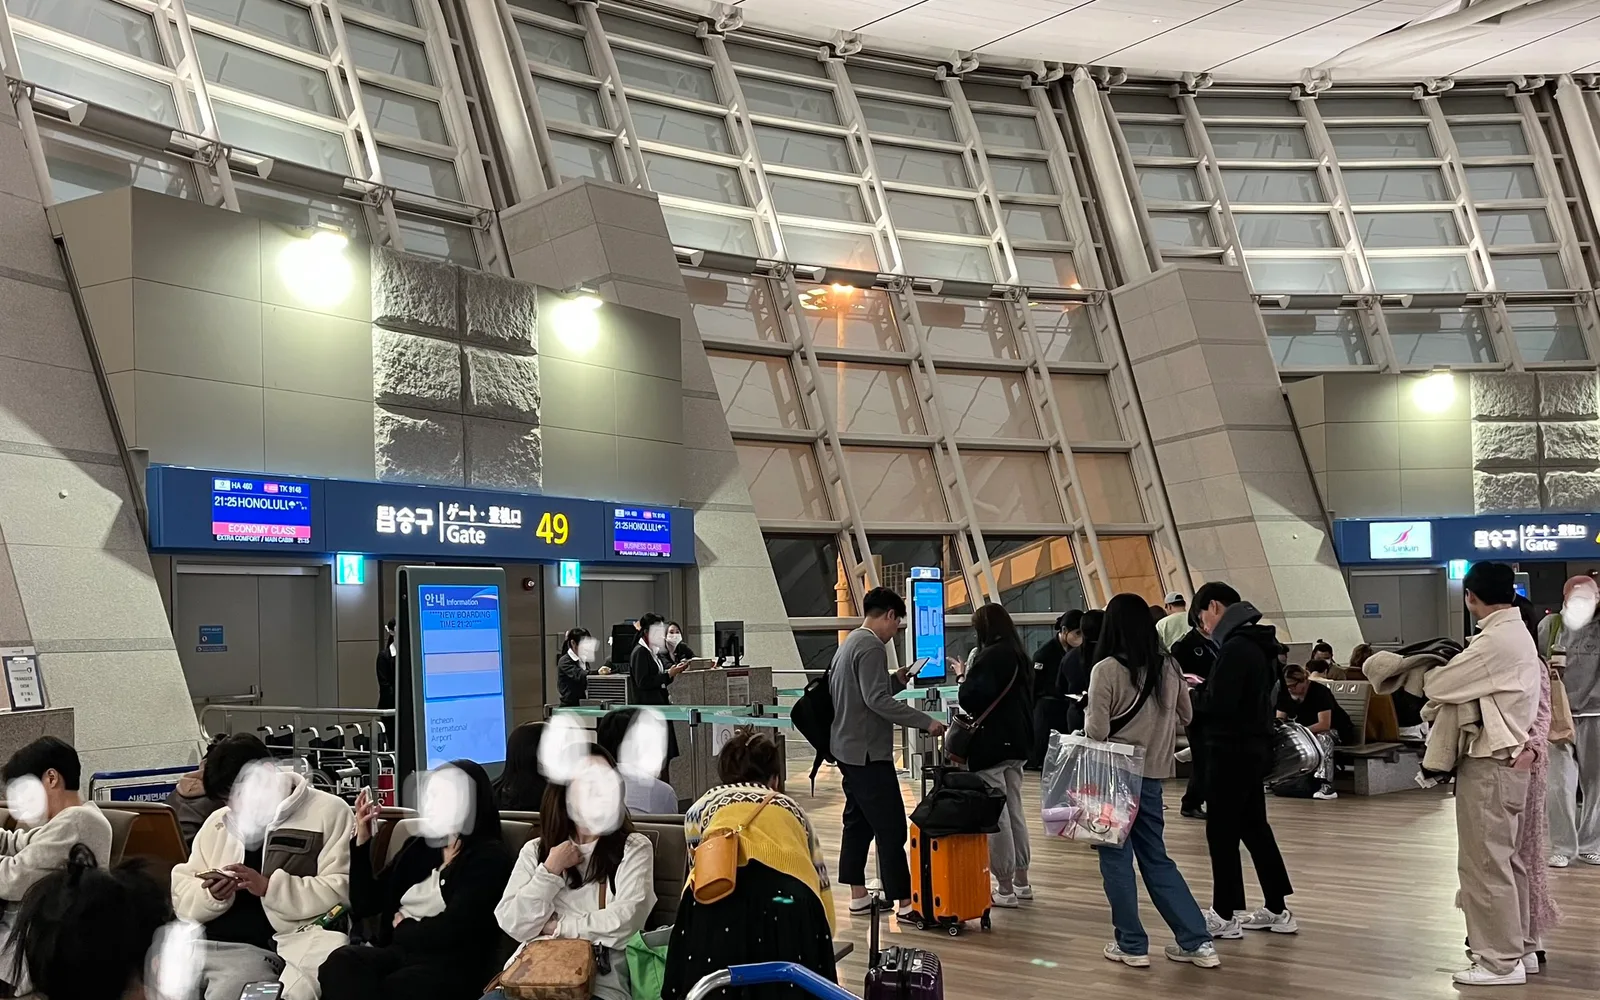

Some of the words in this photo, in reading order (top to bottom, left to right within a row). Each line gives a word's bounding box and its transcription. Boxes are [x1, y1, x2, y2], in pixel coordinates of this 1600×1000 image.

[215, 496, 237, 507] 21:25
[376, 505, 434, 535] 탑승구
[228, 524, 268, 534] ECONOMY
[271, 526, 296, 535] CLASS
[536, 512, 569, 544] 49
[446, 525, 486, 544] Gate
[1526, 540, 1557, 552] Gate
[425, 593, 445, 606] 안내
[431, 723, 467, 733] International
[431, 734, 452, 743] Airport
